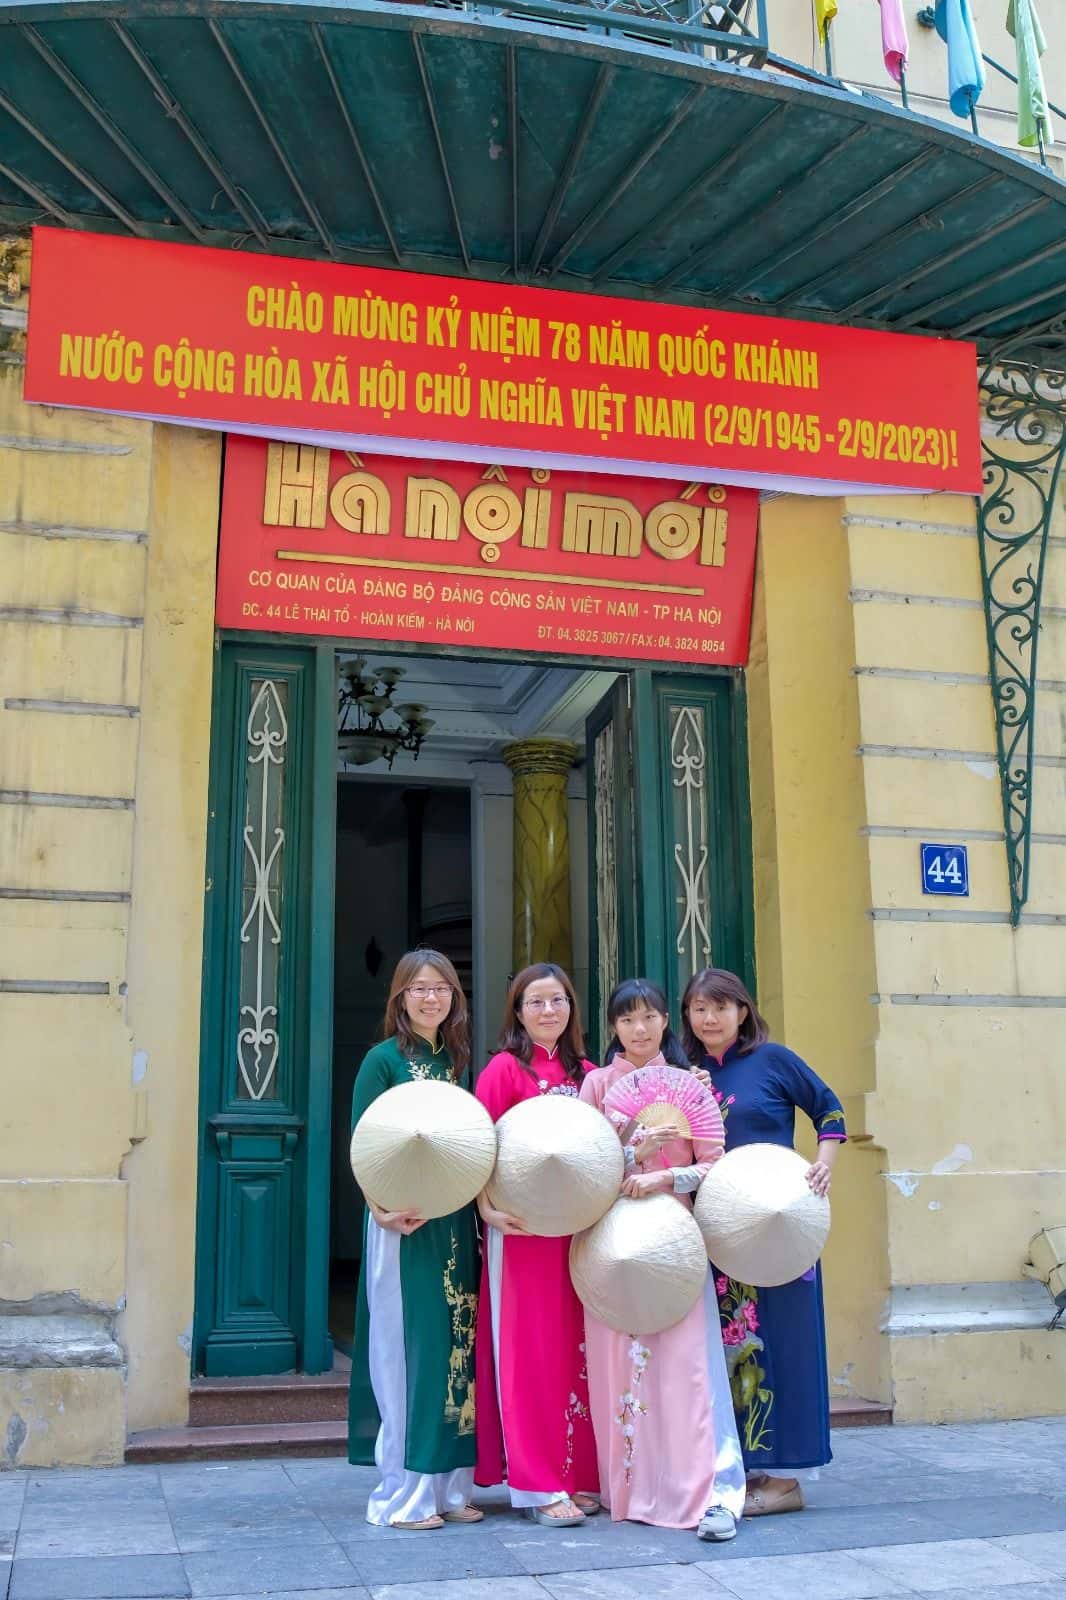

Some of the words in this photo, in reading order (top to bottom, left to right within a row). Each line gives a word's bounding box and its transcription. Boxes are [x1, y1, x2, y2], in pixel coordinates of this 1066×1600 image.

[247, 281, 324, 333] CHÀO
[333, 289, 417, 343] MỪNG
[426, 295, 462, 348] KỶ
[470, 306, 540, 363] NIỆM
[548, 321, 581, 362] 78
[589, 320, 650, 370] NĂM
[658, 325, 726, 378] QUỐC
[734, 338, 819, 389] KHÁNH
[59, 330, 144, 384] NƯỚC
[153, 338, 235, 398] CỘNG
[244, 346, 303, 401] HÒA
[311, 355, 350, 405] XÃ
[359, 360, 406, 419] HỘI
[415, 362, 471, 417] CHỦ
[480, 376, 564, 427] NGHĨA
[571, 384, 627, 441] VIỆT
[635, 396, 695, 440] NAM
[249, 570, 272, 587] CƠ
[276, 572, 320, 591] QUAN
[325, 572, 357, 594] CỦA
[413, 581, 435, 603] BỘ
[441, 582, 484, 605] ĐẢNG
[490, 588, 531, 611] CỘNG
[536, 590, 565, 612] SẢN
[570, 595, 602, 617] VIỆT
[606, 601, 639, 617] NAM
[653, 604, 670, 620] TP
[698, 606, 721, 628] NỘI
[266, 604, 281, 619] 44
[701, 638, 726, 653] 8054
[927, 855, 962, 884] 44
